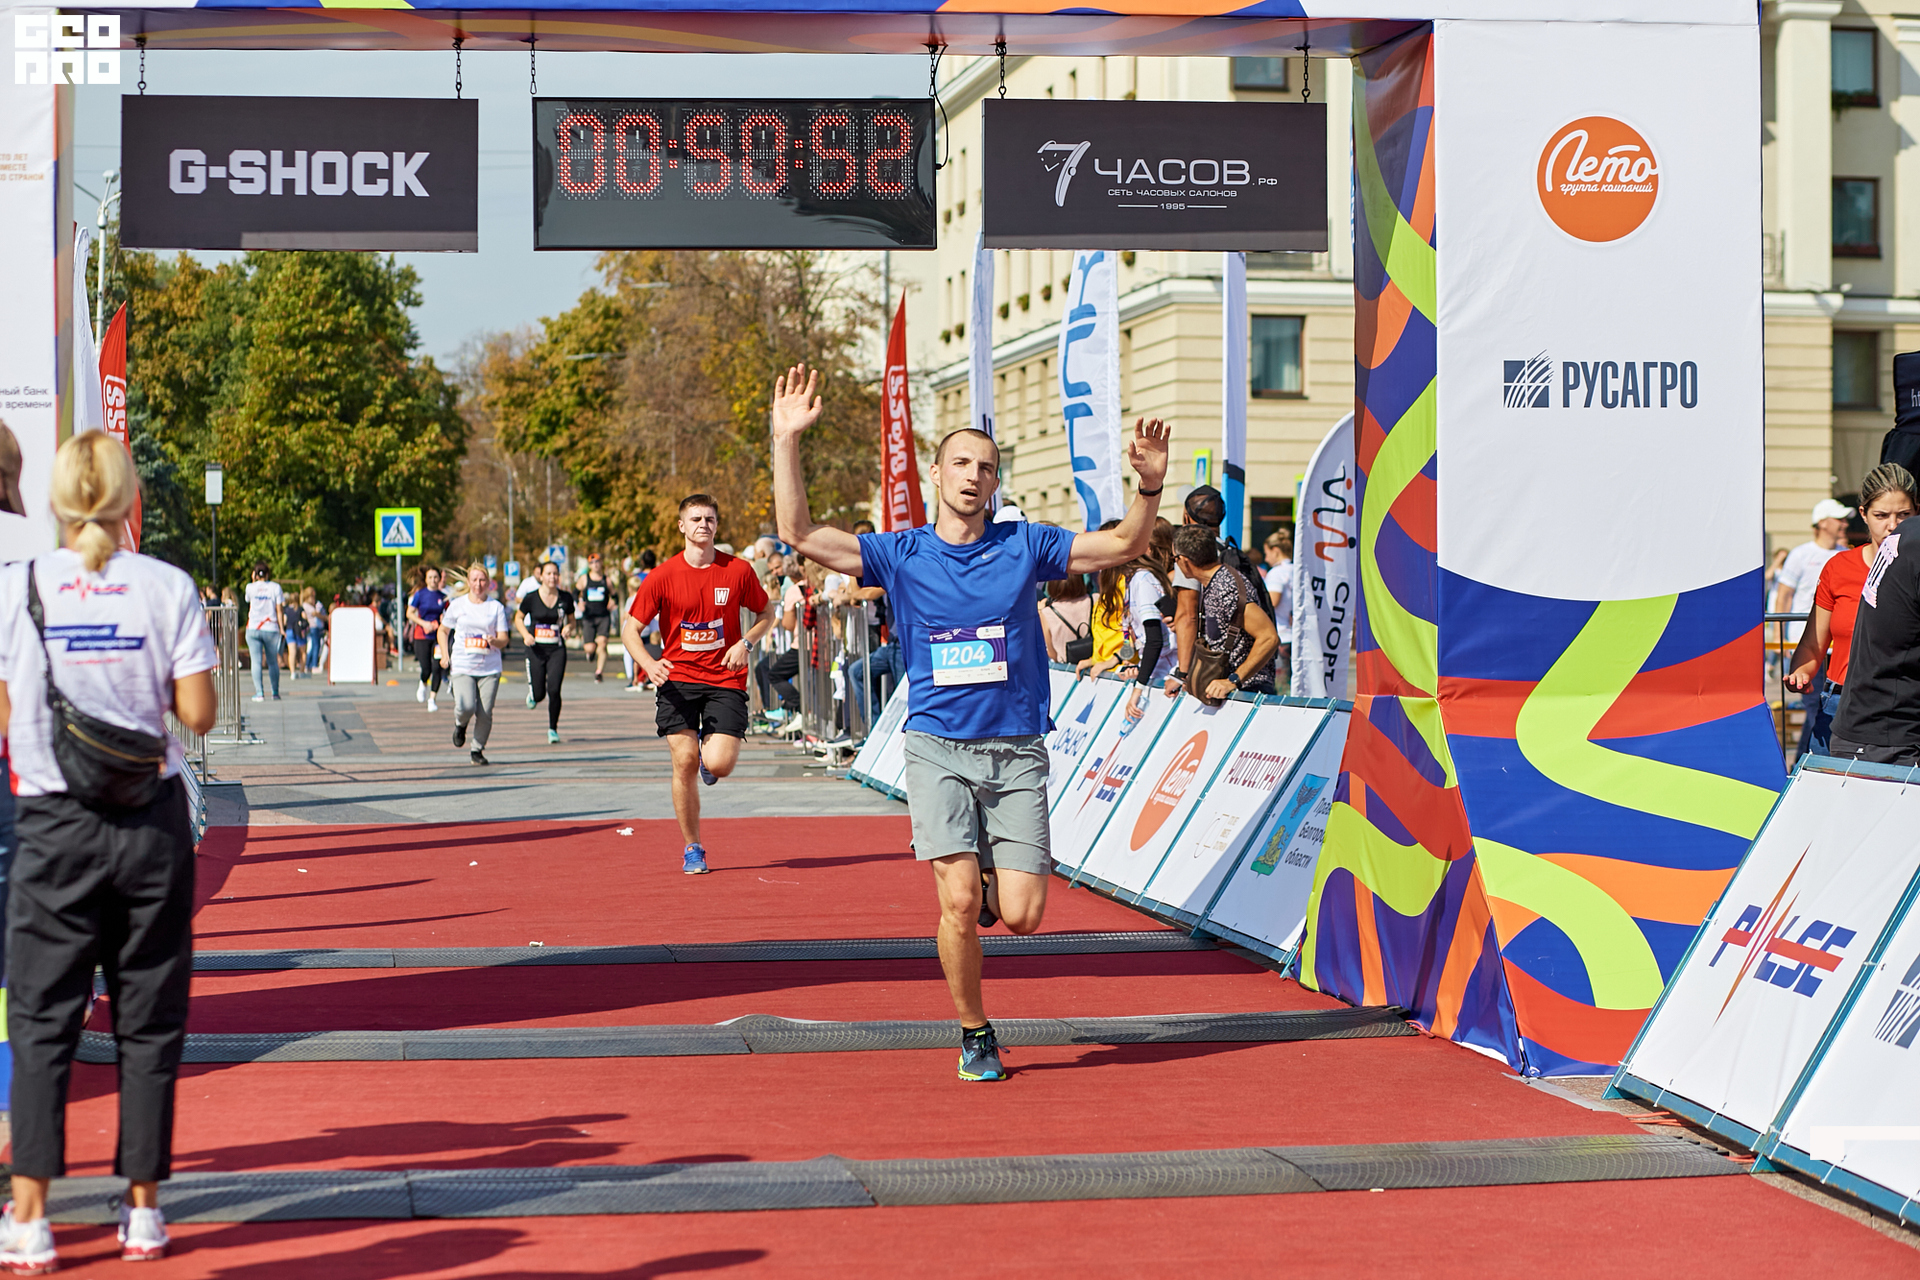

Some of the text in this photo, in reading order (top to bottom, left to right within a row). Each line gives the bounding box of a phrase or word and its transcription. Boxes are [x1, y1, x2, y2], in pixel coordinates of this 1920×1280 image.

[1545, 129, 1659, 192] Лето
[169, 149, 430, 197] G-SHOCK
[1136, 189, 1186, 197] ЧАСОВЫХ
[1189, 189, 1237, 197] САЛОНОВ
[1560, 182, 1653, 196] группа компаний
[23, 386, 48, 395] банк
[1562, 360, 1698, 409] РУСАГРО
[5, 401, 52, 411] времени
[684, 631, 715, 642] 5422
[941, 645, 986, 666] 1204
